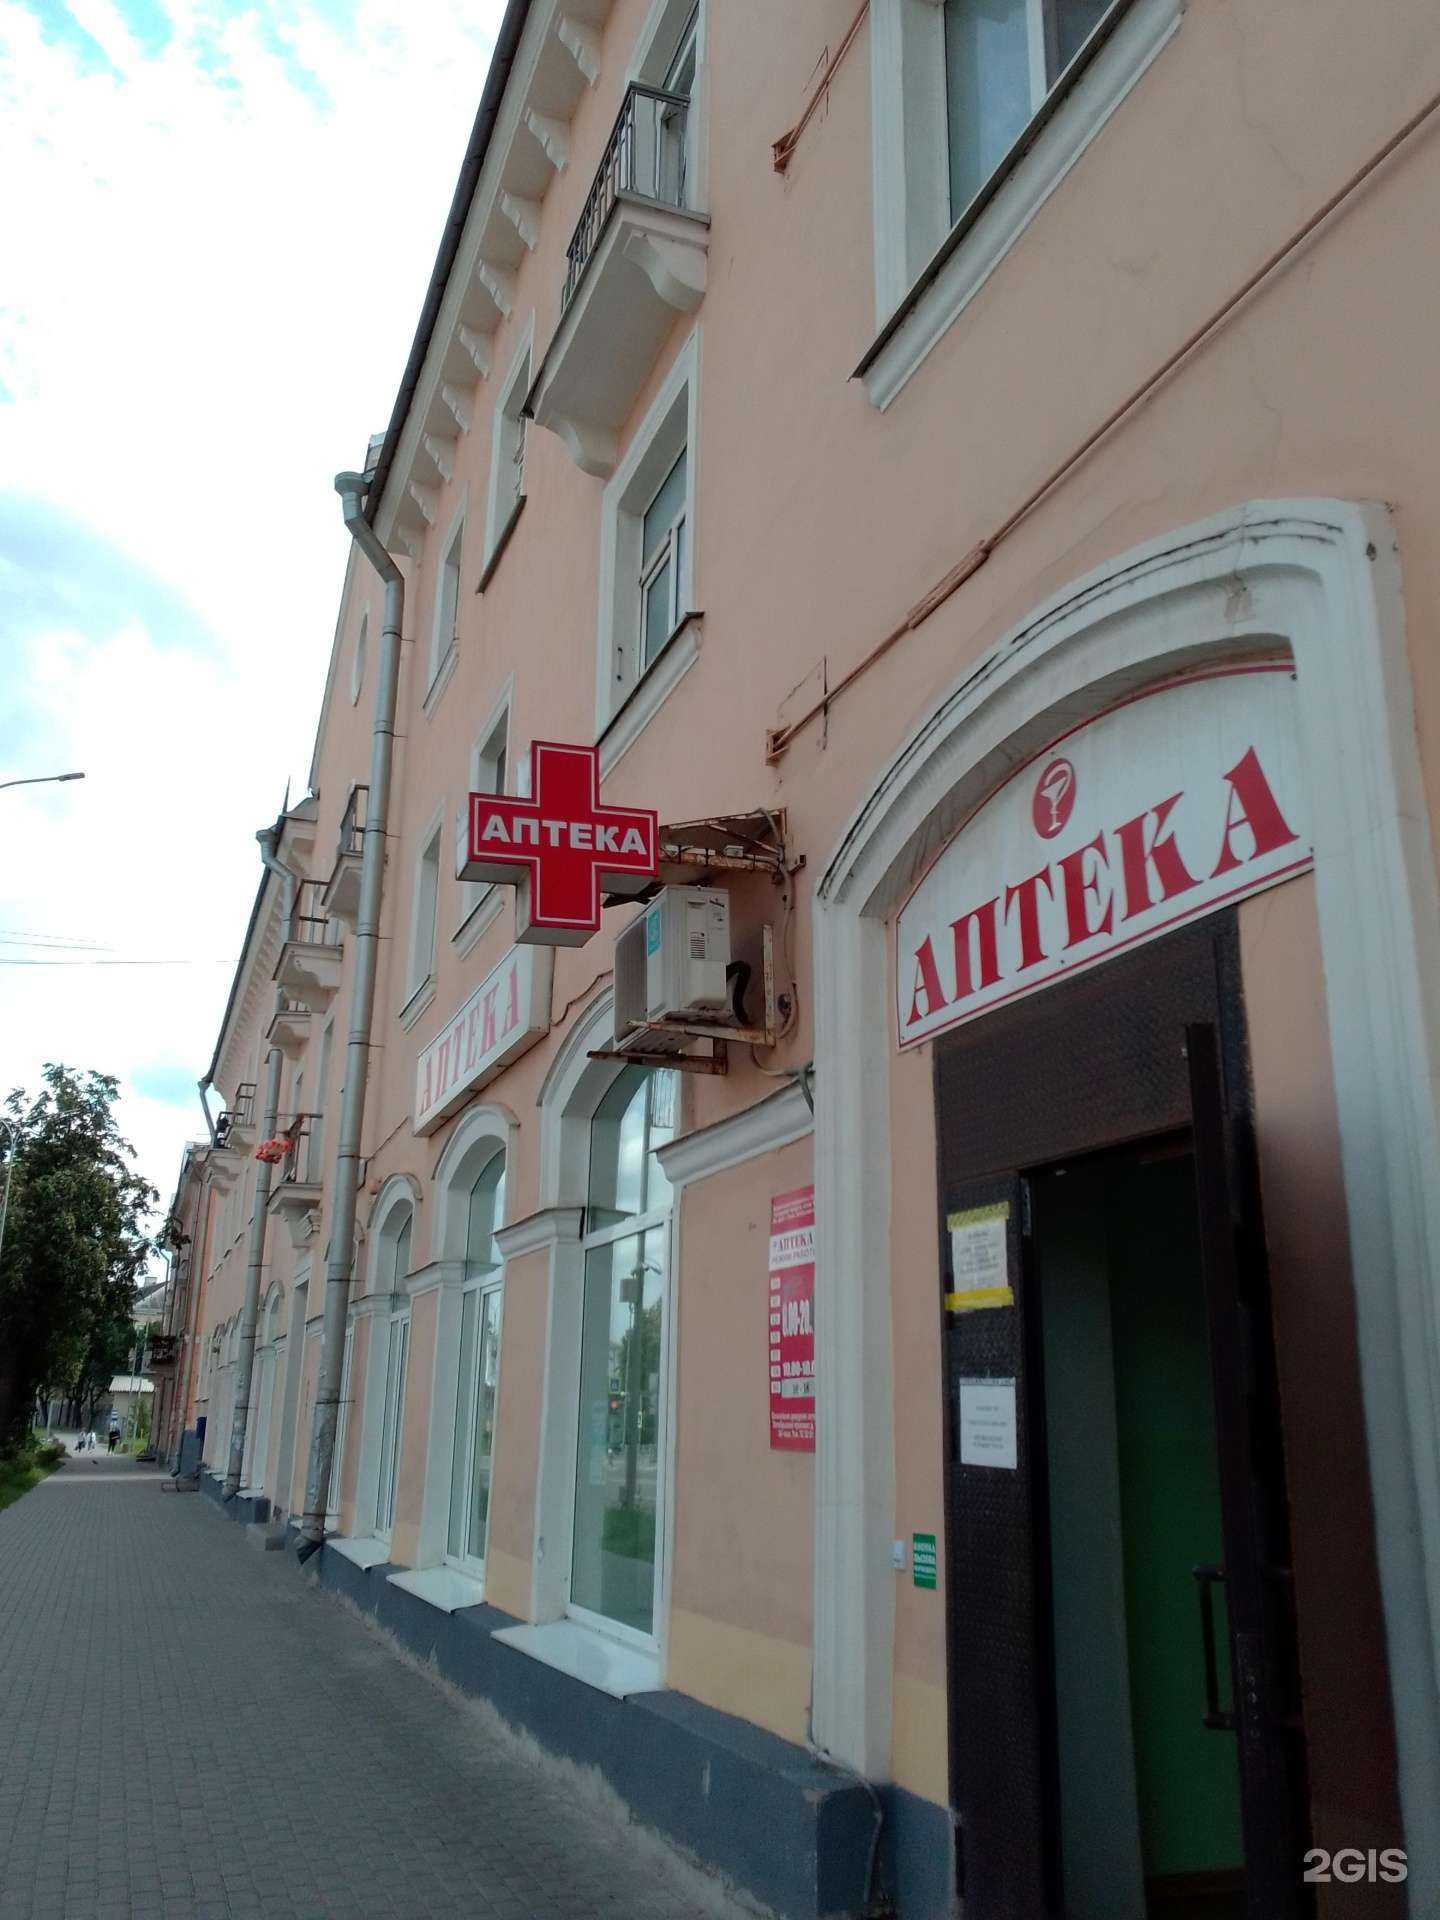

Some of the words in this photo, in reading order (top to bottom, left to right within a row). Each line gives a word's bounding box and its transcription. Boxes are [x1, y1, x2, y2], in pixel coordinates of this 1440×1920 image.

[481, 814, 648, 856] АПТЕКА
[906, 745, 1300, 1026] АПТЕКА
[420, 961, 520, 1117] АПТЕКА
